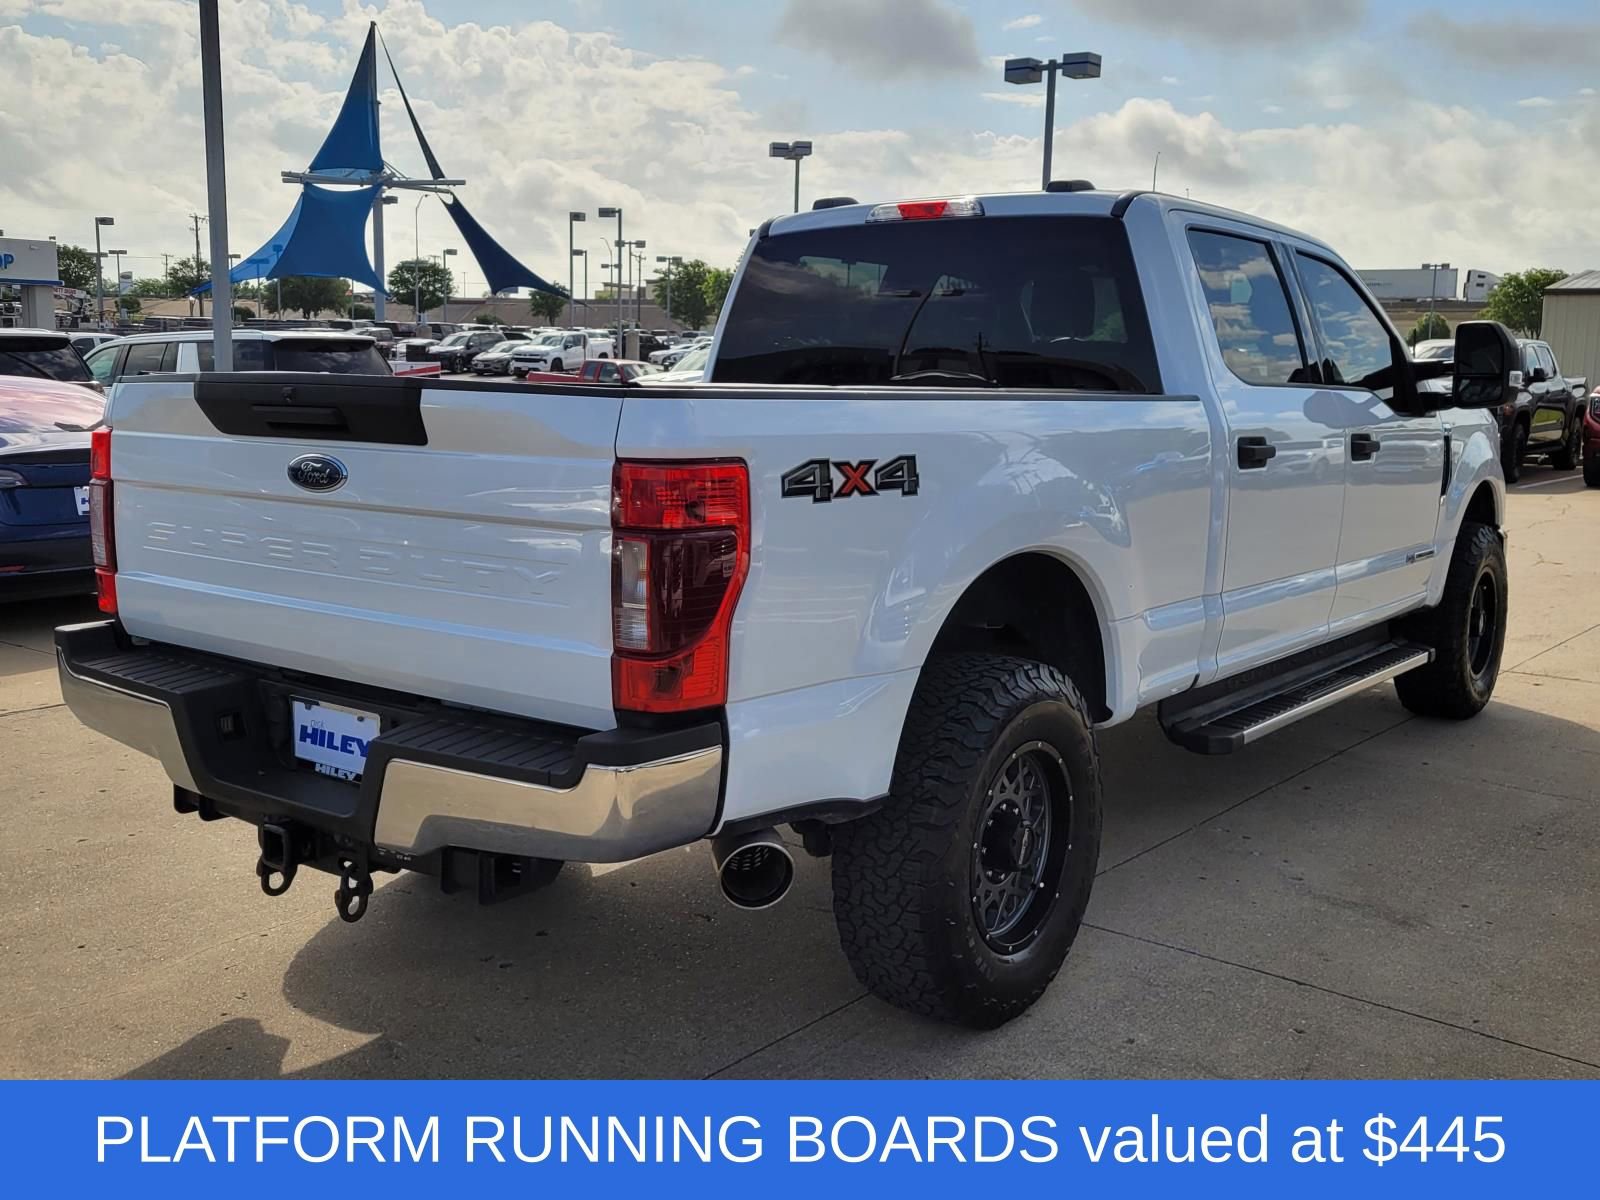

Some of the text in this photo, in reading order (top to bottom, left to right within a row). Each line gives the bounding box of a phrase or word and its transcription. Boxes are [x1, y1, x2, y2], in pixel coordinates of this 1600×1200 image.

[0, 253, 15, 269] P
[299, 724, 371, 758] HILEY
[314, 763, 356, 781] HILEY
